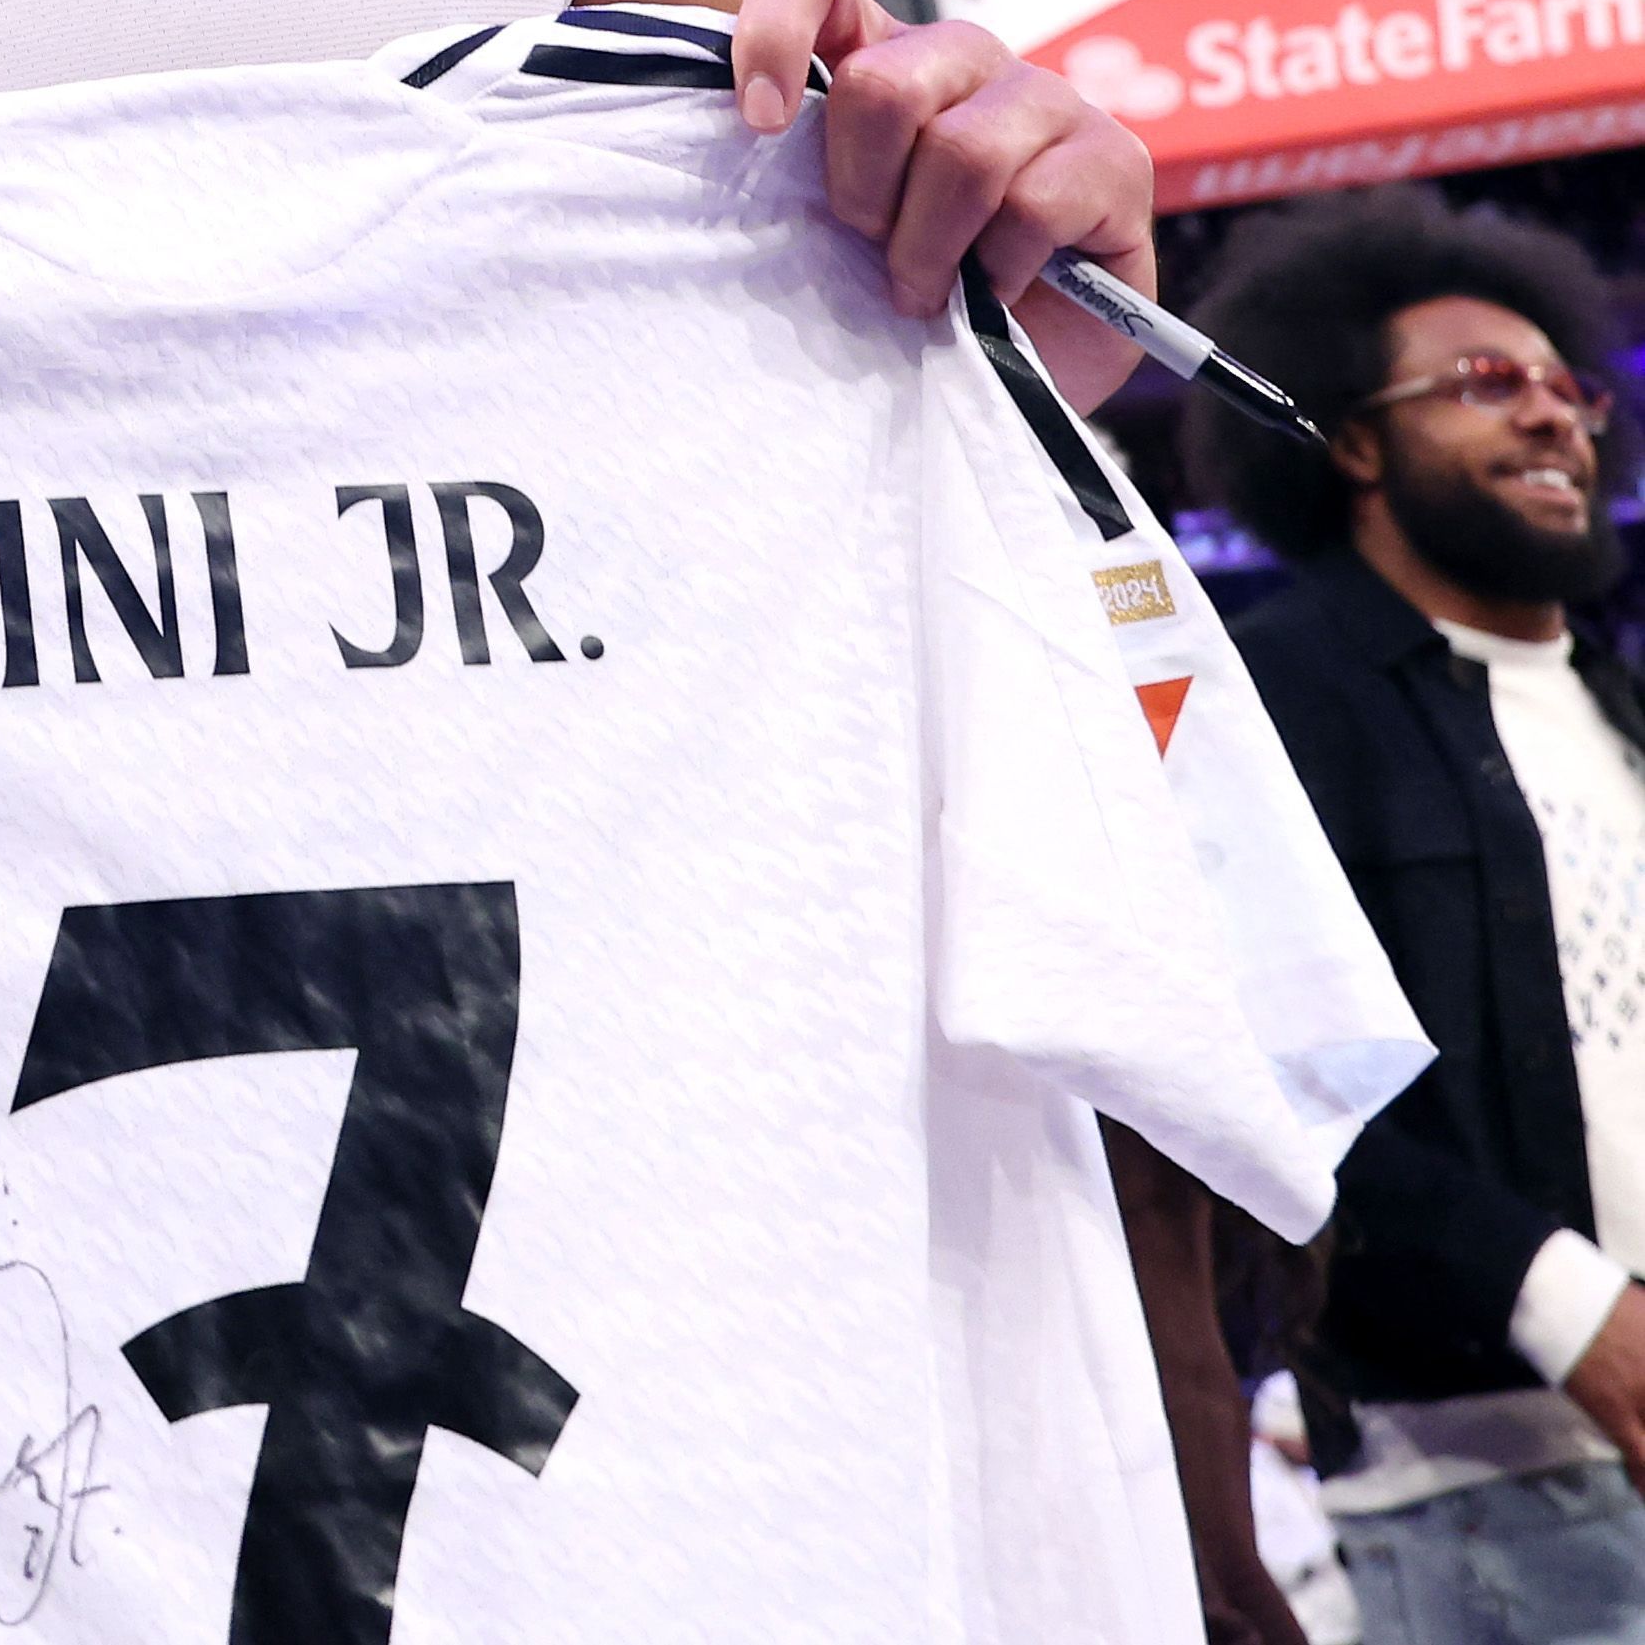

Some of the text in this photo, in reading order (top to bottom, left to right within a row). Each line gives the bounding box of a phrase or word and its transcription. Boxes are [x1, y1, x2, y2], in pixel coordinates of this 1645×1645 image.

[328, 481, 605, 670] JR.
[1096, 575, 1163, 612] 2024
[10, 880, 580, 1645] 7
